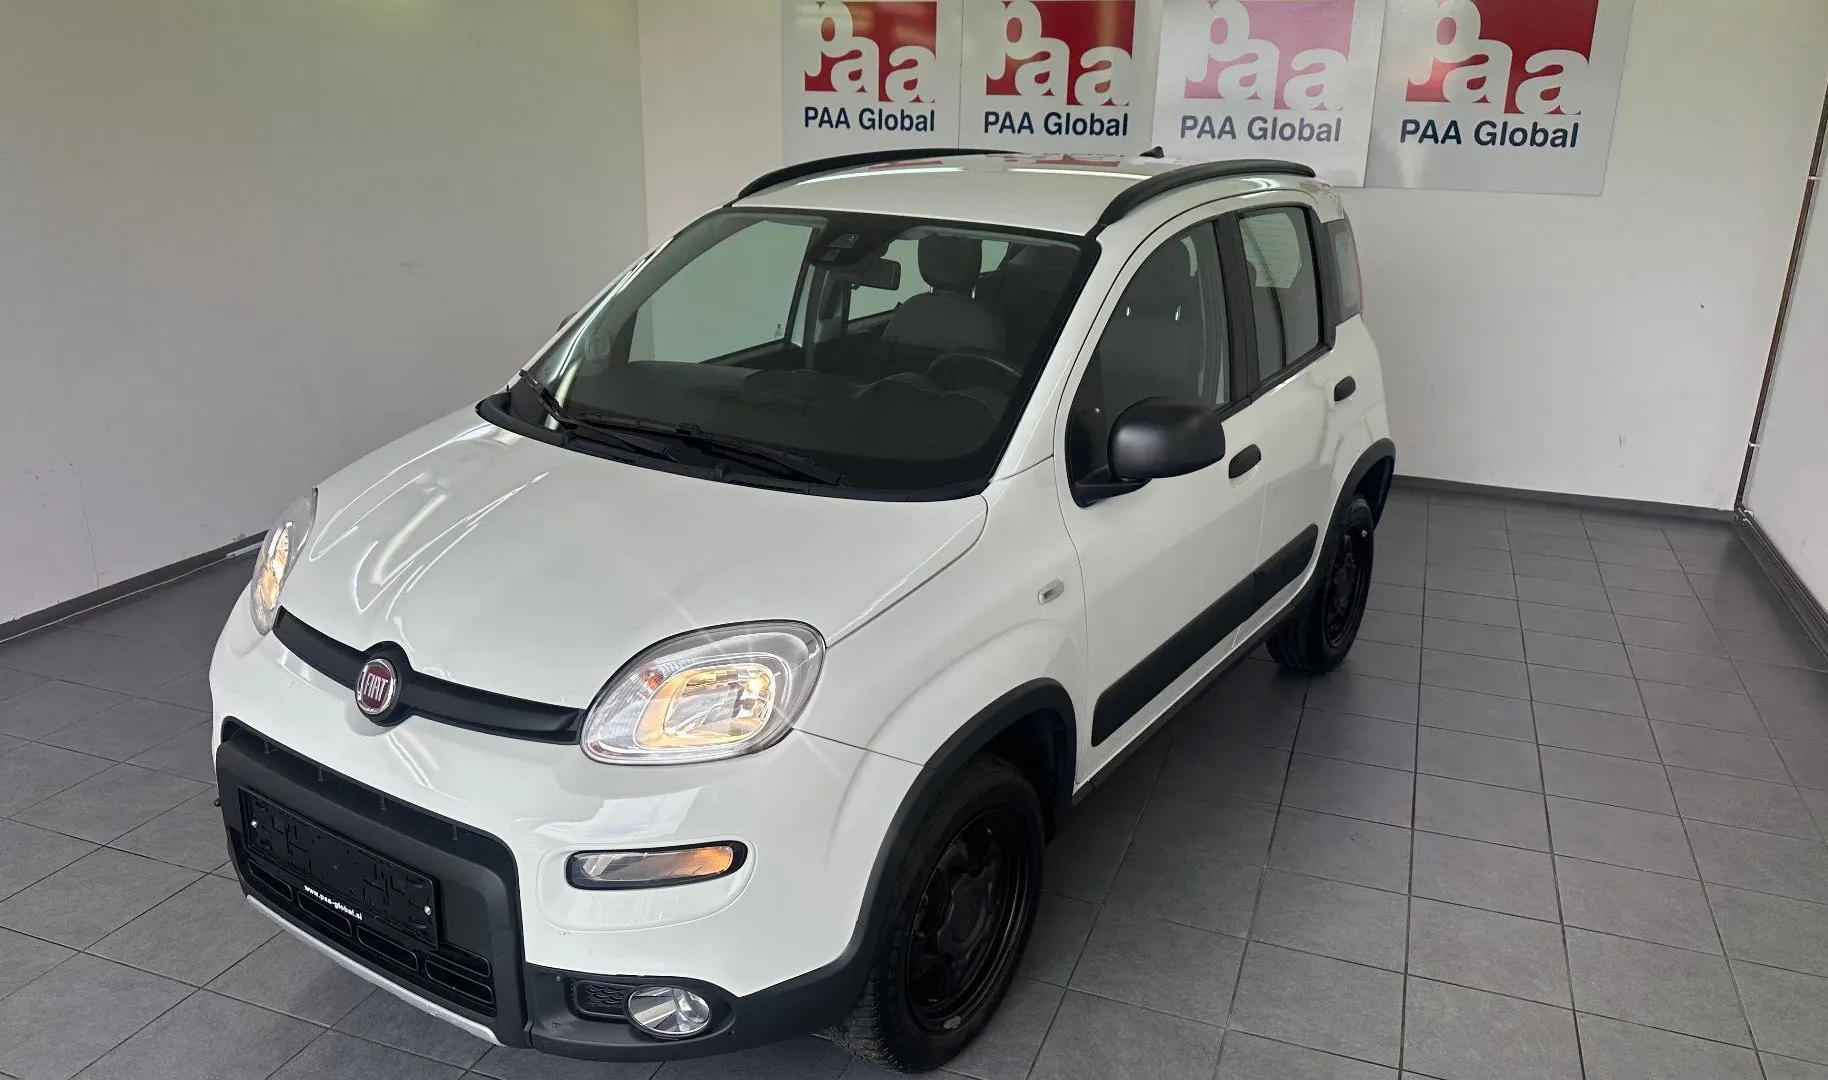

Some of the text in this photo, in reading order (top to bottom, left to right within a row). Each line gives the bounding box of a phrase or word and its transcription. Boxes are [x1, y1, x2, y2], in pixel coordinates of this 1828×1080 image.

[804, 106, 935, 132] PAA Global
[983, 111, 1129, 137] PAA Global
[1180, 115, 1342, 142] PAA Global
[1399, 119, 1579, 148] PAA Global
[363, 672, 389, 702] FIAT
